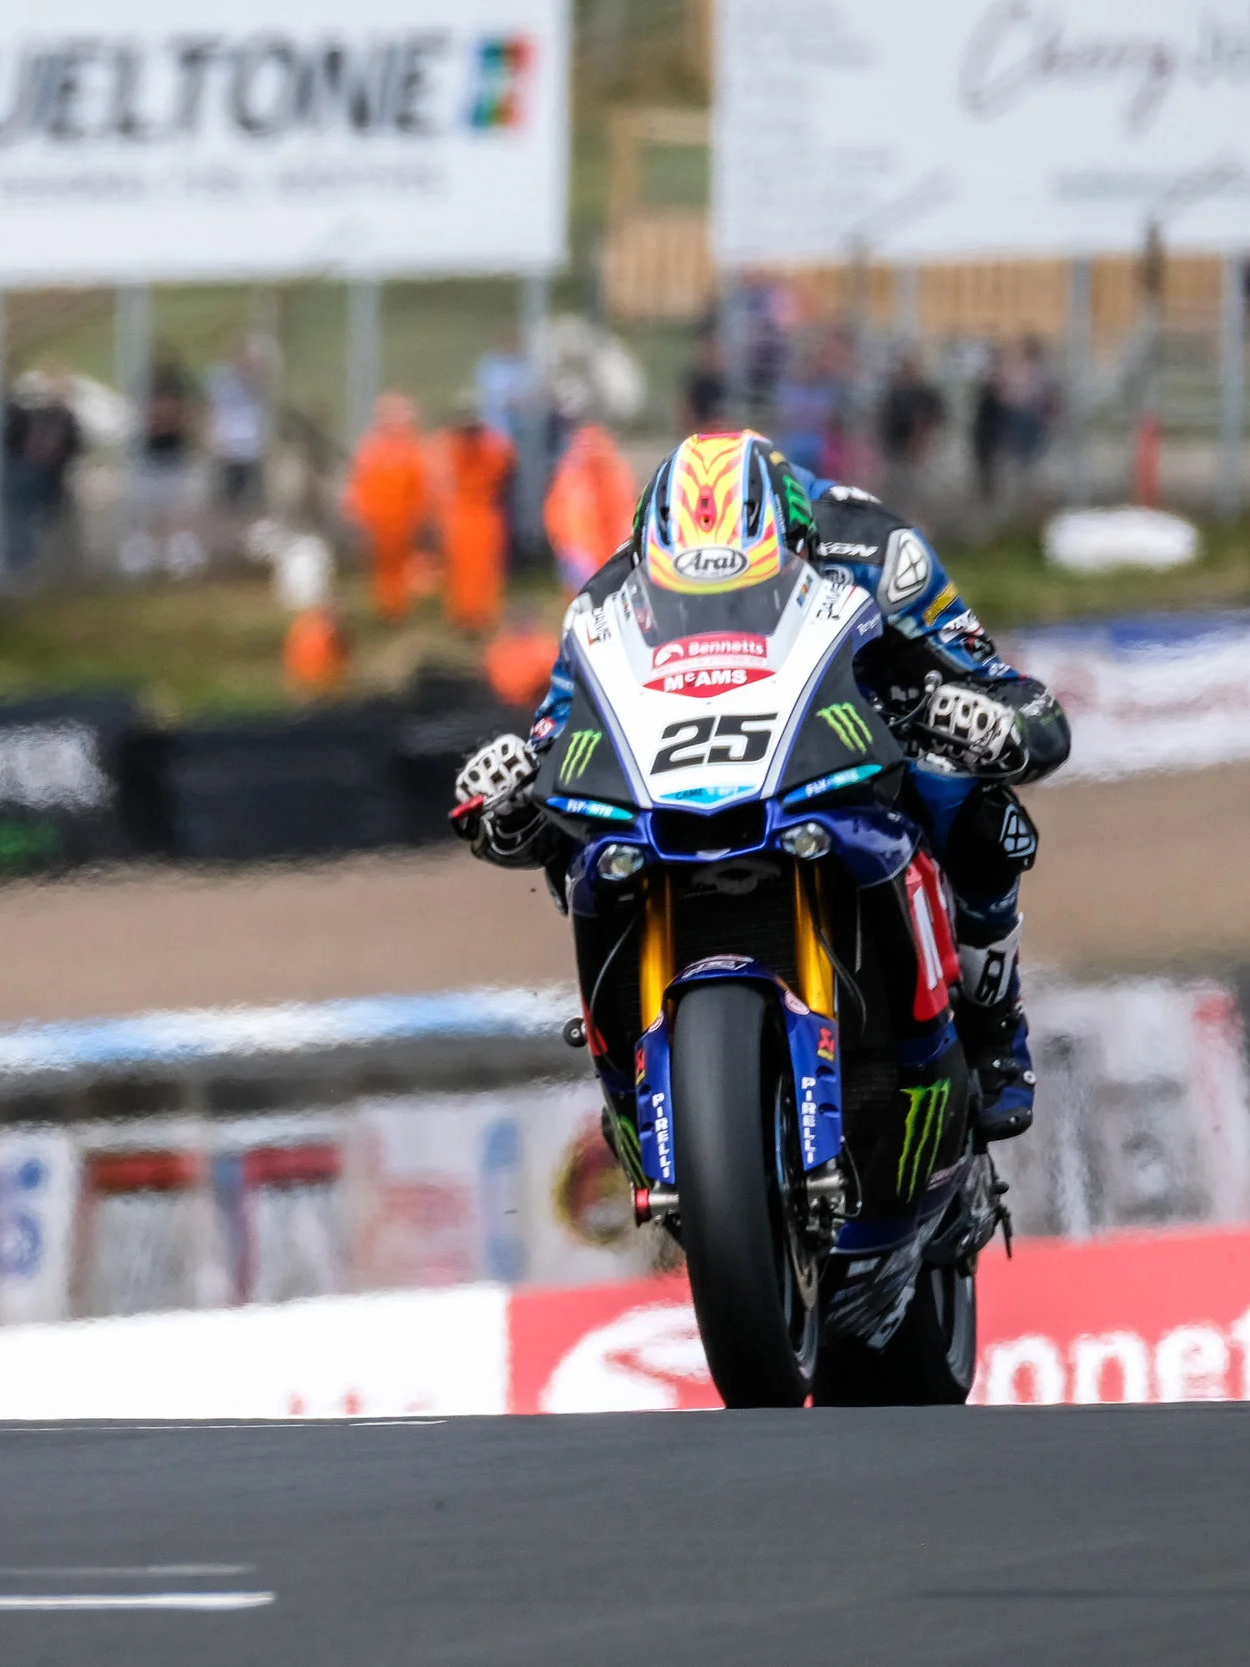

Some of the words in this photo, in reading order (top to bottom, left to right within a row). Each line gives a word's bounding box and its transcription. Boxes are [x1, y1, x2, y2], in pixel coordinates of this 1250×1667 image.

[682, 549, 738, 571] Arai
[688, 639, 764, 656] Bennetts
[663, 669, 748, 693] McAMS
[649, 713, 779, 776] 25
[652, 1092, 672, 1179] PIRELLI
[801, 1076, 817, 1165] PIRELLI
